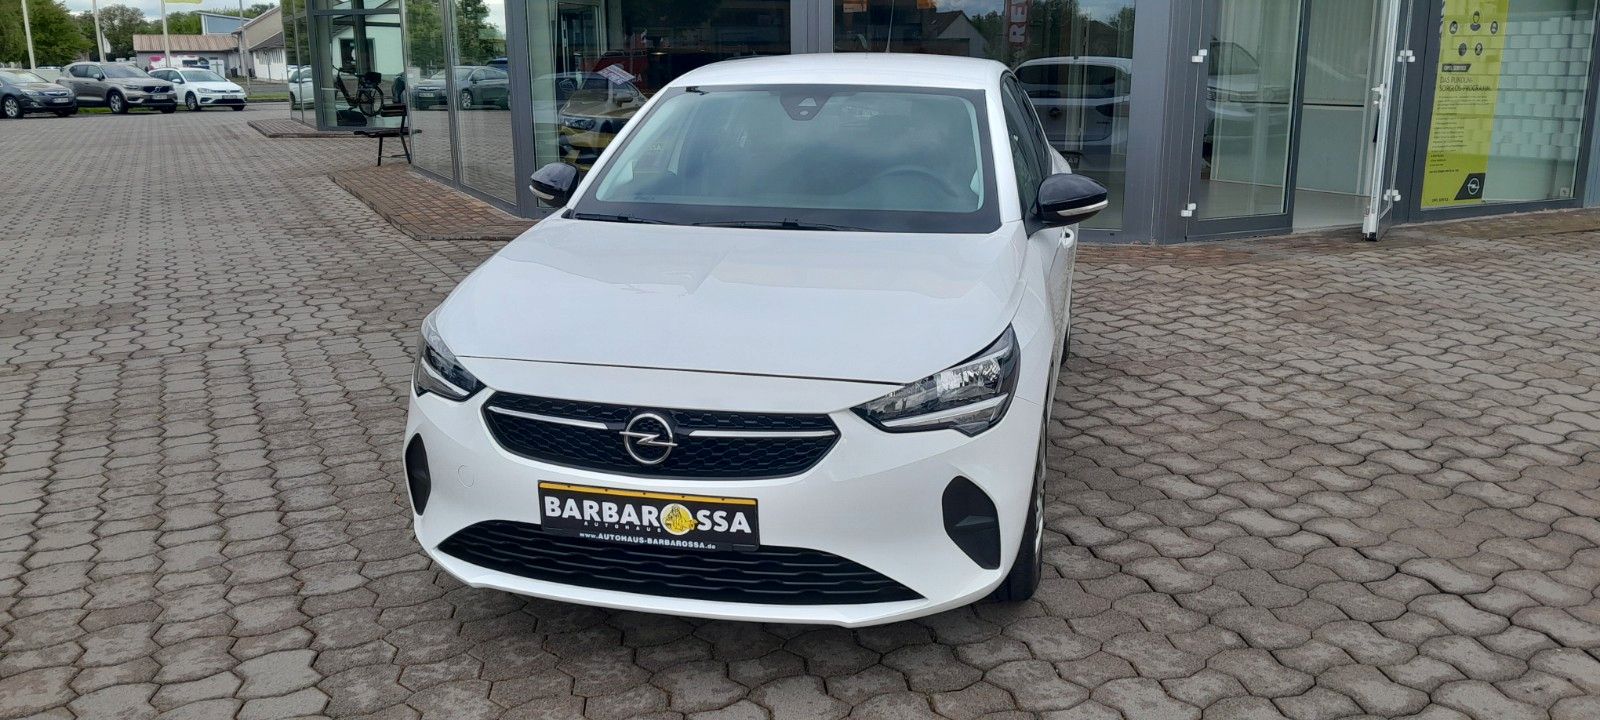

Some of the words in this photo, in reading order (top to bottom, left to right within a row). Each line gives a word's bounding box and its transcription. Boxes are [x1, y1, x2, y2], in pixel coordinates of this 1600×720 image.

[544, 496, 752, 535] BARBAROSSA
[583, 521, 662, 533] AUTOHAUS
[579, 532, 716, 550] www.AUTOHAUS-BARBAROSSA.de
